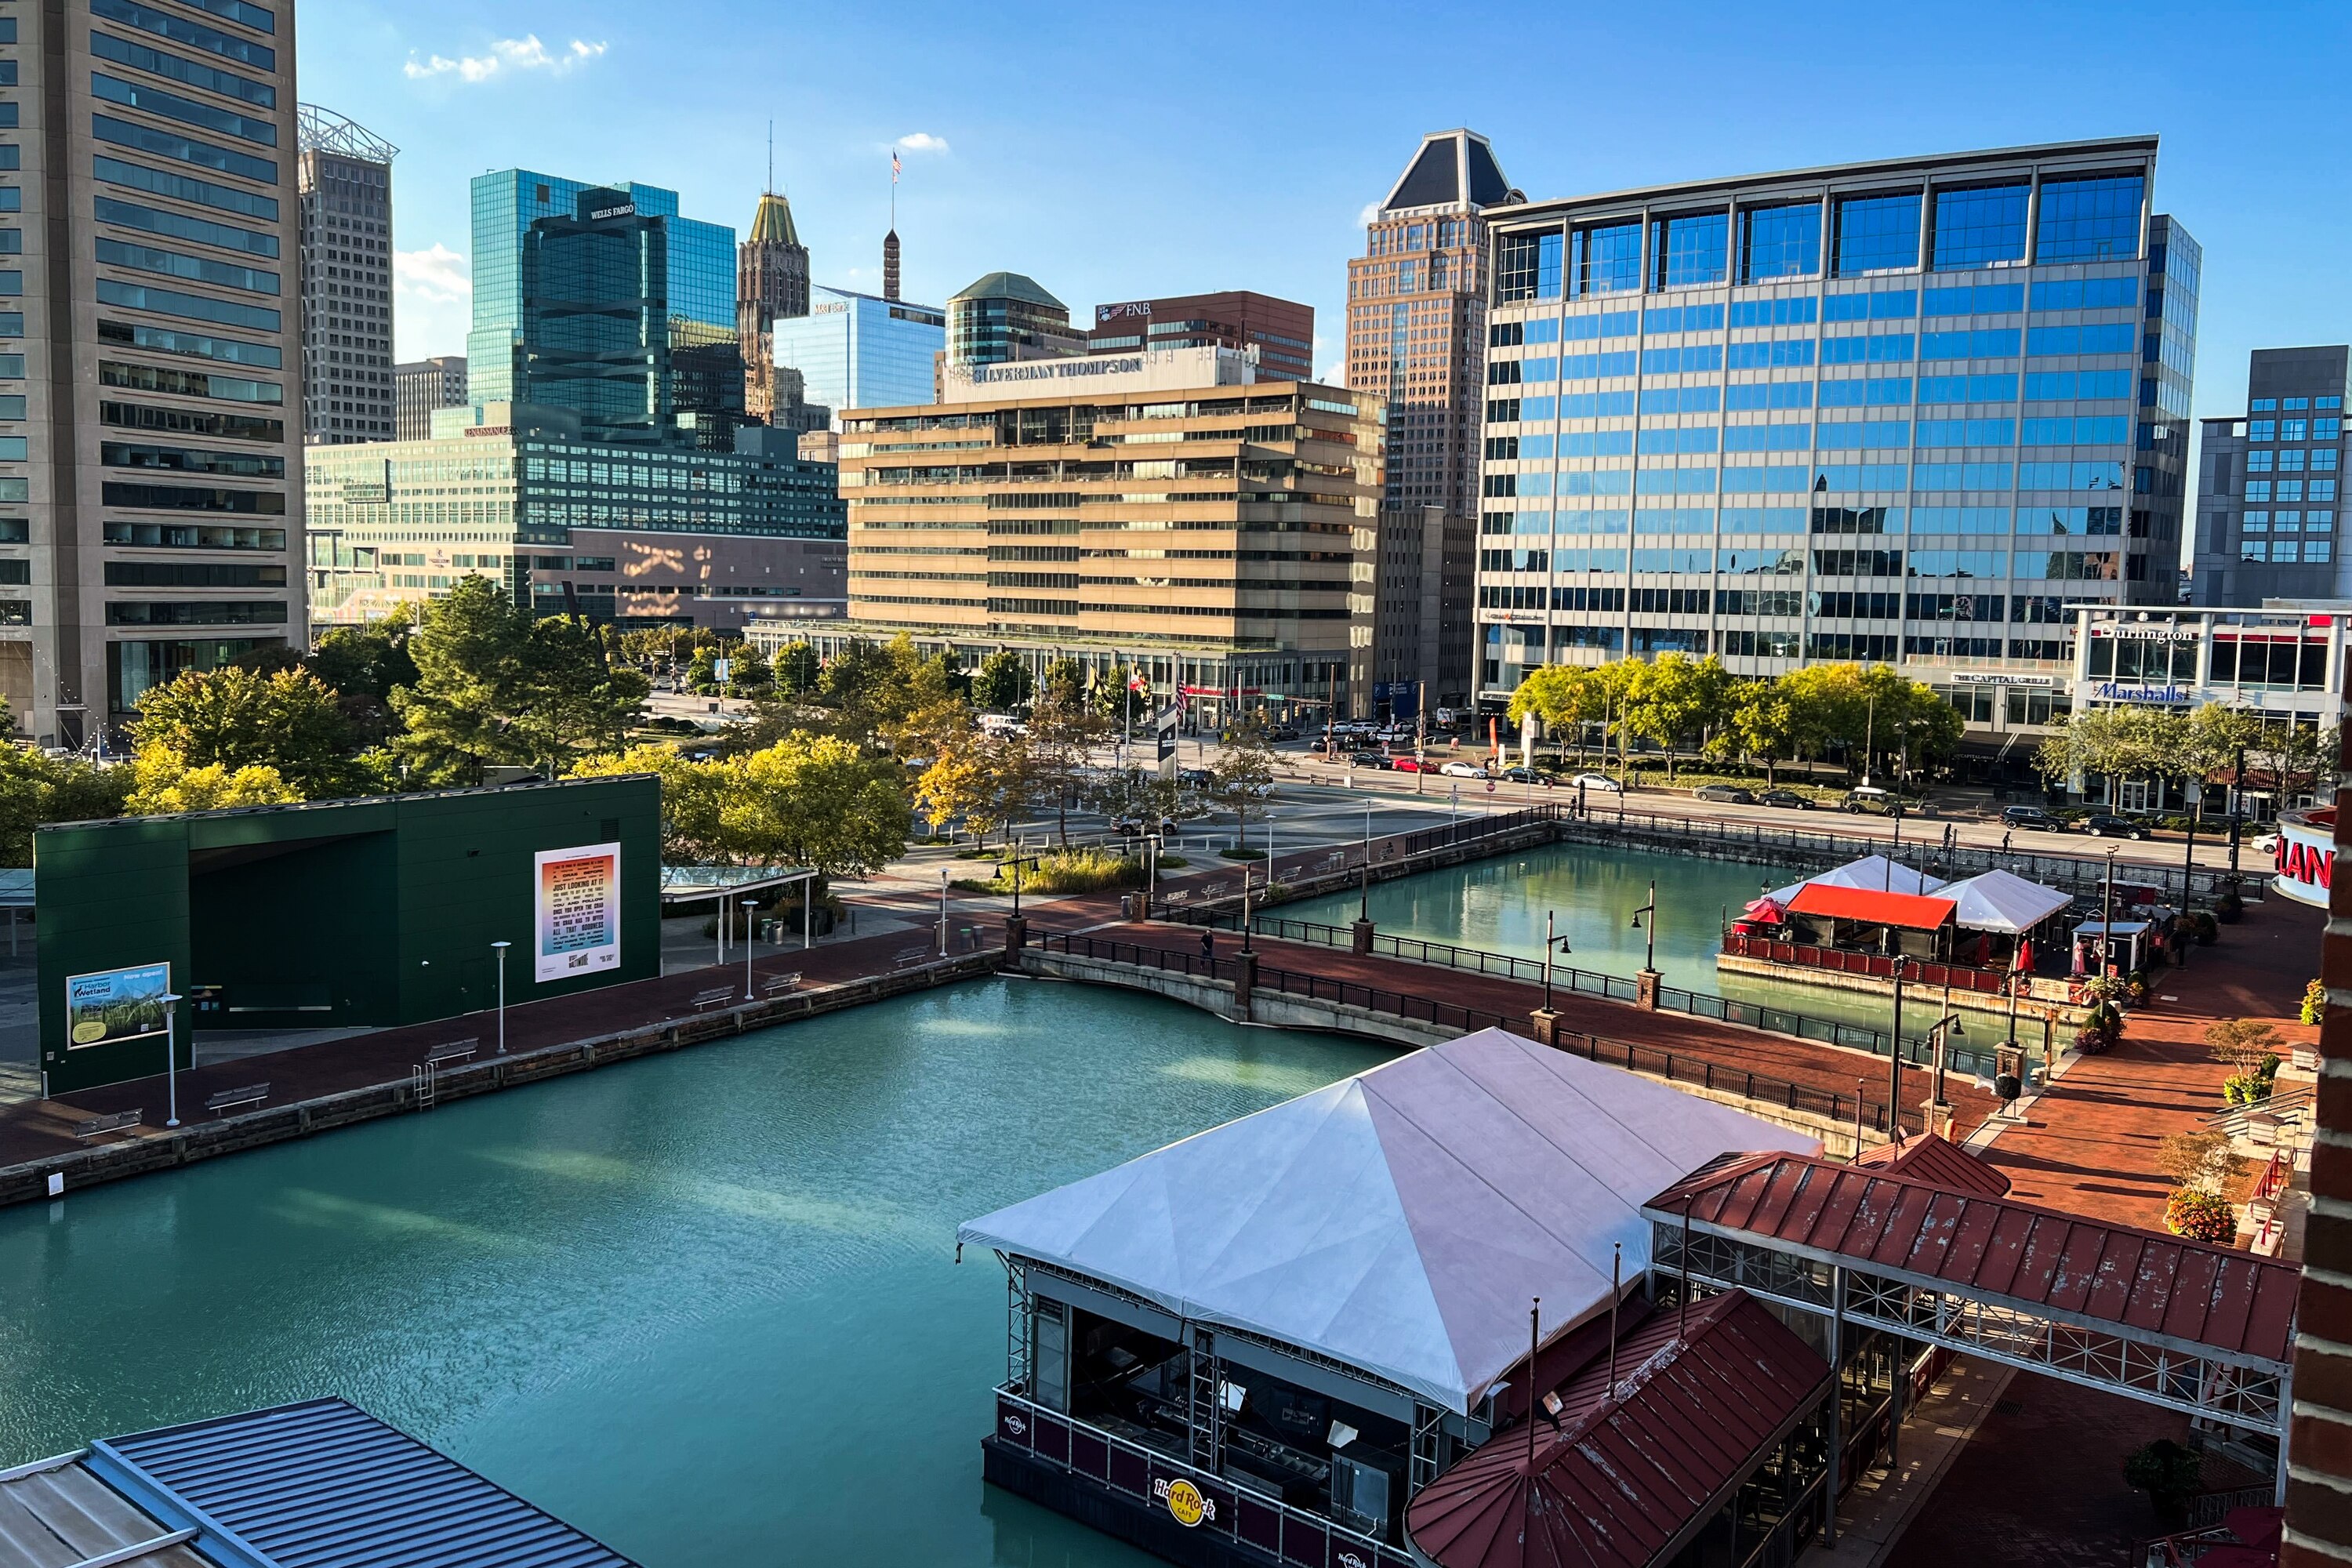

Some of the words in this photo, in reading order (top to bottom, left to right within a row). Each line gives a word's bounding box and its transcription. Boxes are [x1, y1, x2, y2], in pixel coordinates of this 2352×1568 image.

[591, 209, 612, 220] WELLS
[613, 204, 633, 216] FARGO
[815, 303, 831, 314] M&T
[974, 365, 1054, 383] SILVERMAN
[1056, 358, 1142, 377] THOMPSON
[465, 426, 508, 437] RENAISSANCE
[2101, 624, 2193, 644] Burlington
[1971, 674, 2017, 684] CAPITAL
[2094, 683, 2185, 702] Marshalls
[554, 883, 566, 891] JUST
[568, 880, 590, 889] LOOKING
[582, 922, 604, 931] GOODNESS
[142, 969, 163, 978] open!
[78, 986, 111, 997] Wetland
[1155, 1479, 1185, 1503] Hard
[1185, 1492, 1215, 1520] Rock
[1178, 1508, 1192, 1518] CAFE
